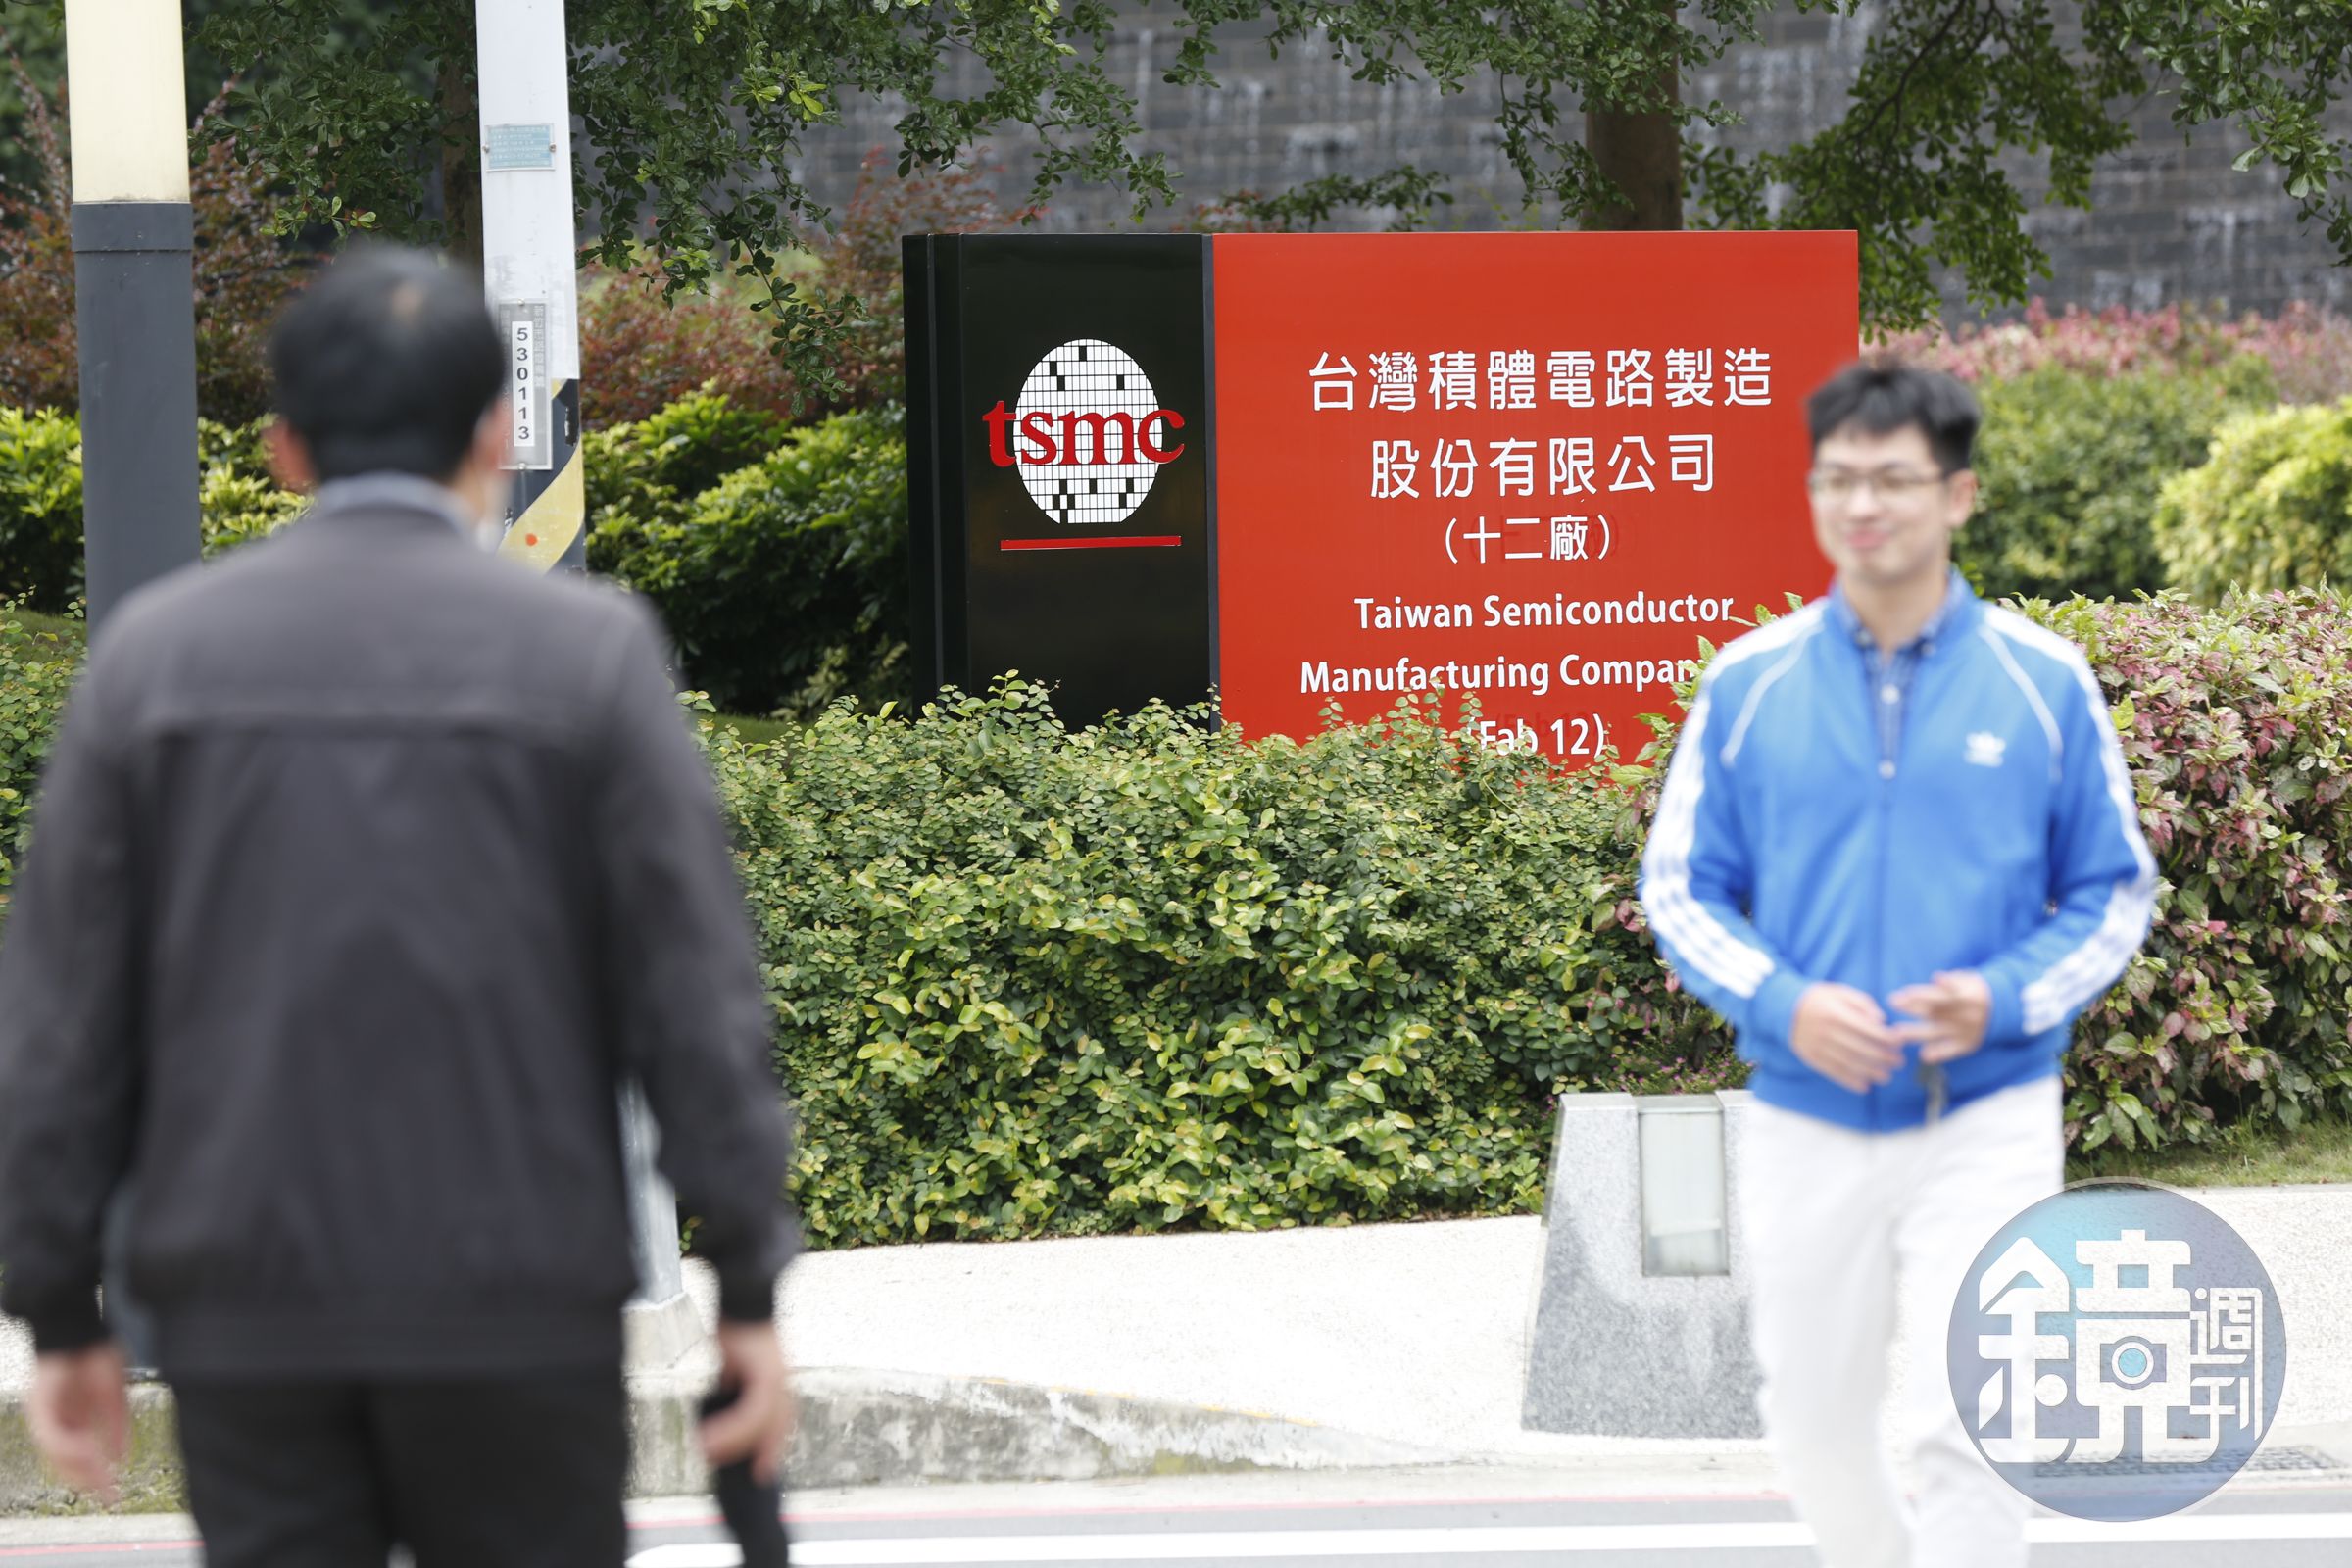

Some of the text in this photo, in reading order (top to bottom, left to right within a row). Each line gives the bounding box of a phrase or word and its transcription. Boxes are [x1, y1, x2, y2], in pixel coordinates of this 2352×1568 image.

[515, 326, 530, 440] 530113
[1308, 347, 1772, 413] 台灣積體電路製造
[982, 400, 1185, 467] tsmc
[1370, 433, 1714, 499] 股份有限公司
[1353, 590, 1734, 629] Taiwan Semiconductor
[1300, 654, 1704, 696] Manufacturing Compan
[1550, 712, 1604, 759] 12)
